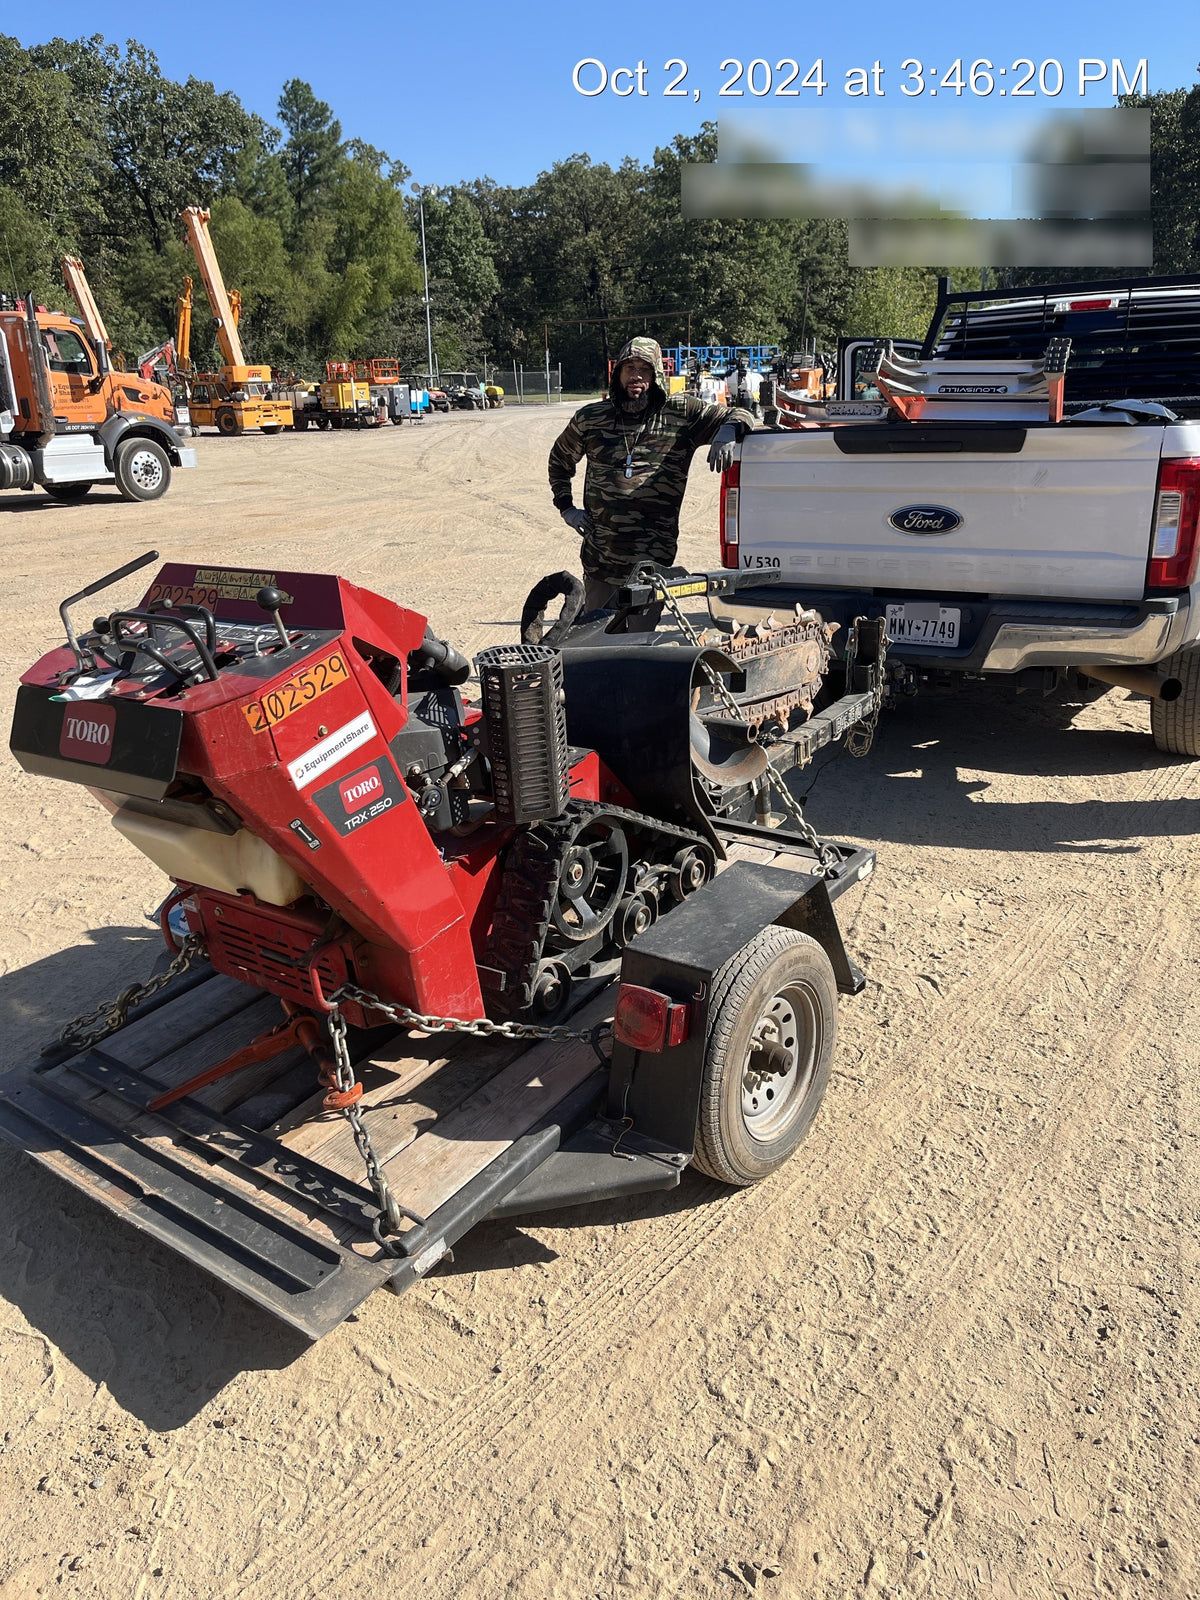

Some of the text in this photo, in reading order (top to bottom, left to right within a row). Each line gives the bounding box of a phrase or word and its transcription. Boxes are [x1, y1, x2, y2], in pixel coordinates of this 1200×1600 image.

[903, 510, 945, 529] Ford
[743, 555, 781, 568] V 530
[150, 584, 219, 614] 202529
[922, 620, 956, 639] 7749
[247, 655, 349, 731] 202529
[66, 717, 111, 746] TORO
[304, 722, 370, 773] EquipmentShare
[343, 776, 380, 803] TORO
[344, 797, 393, 831] TRX-250
